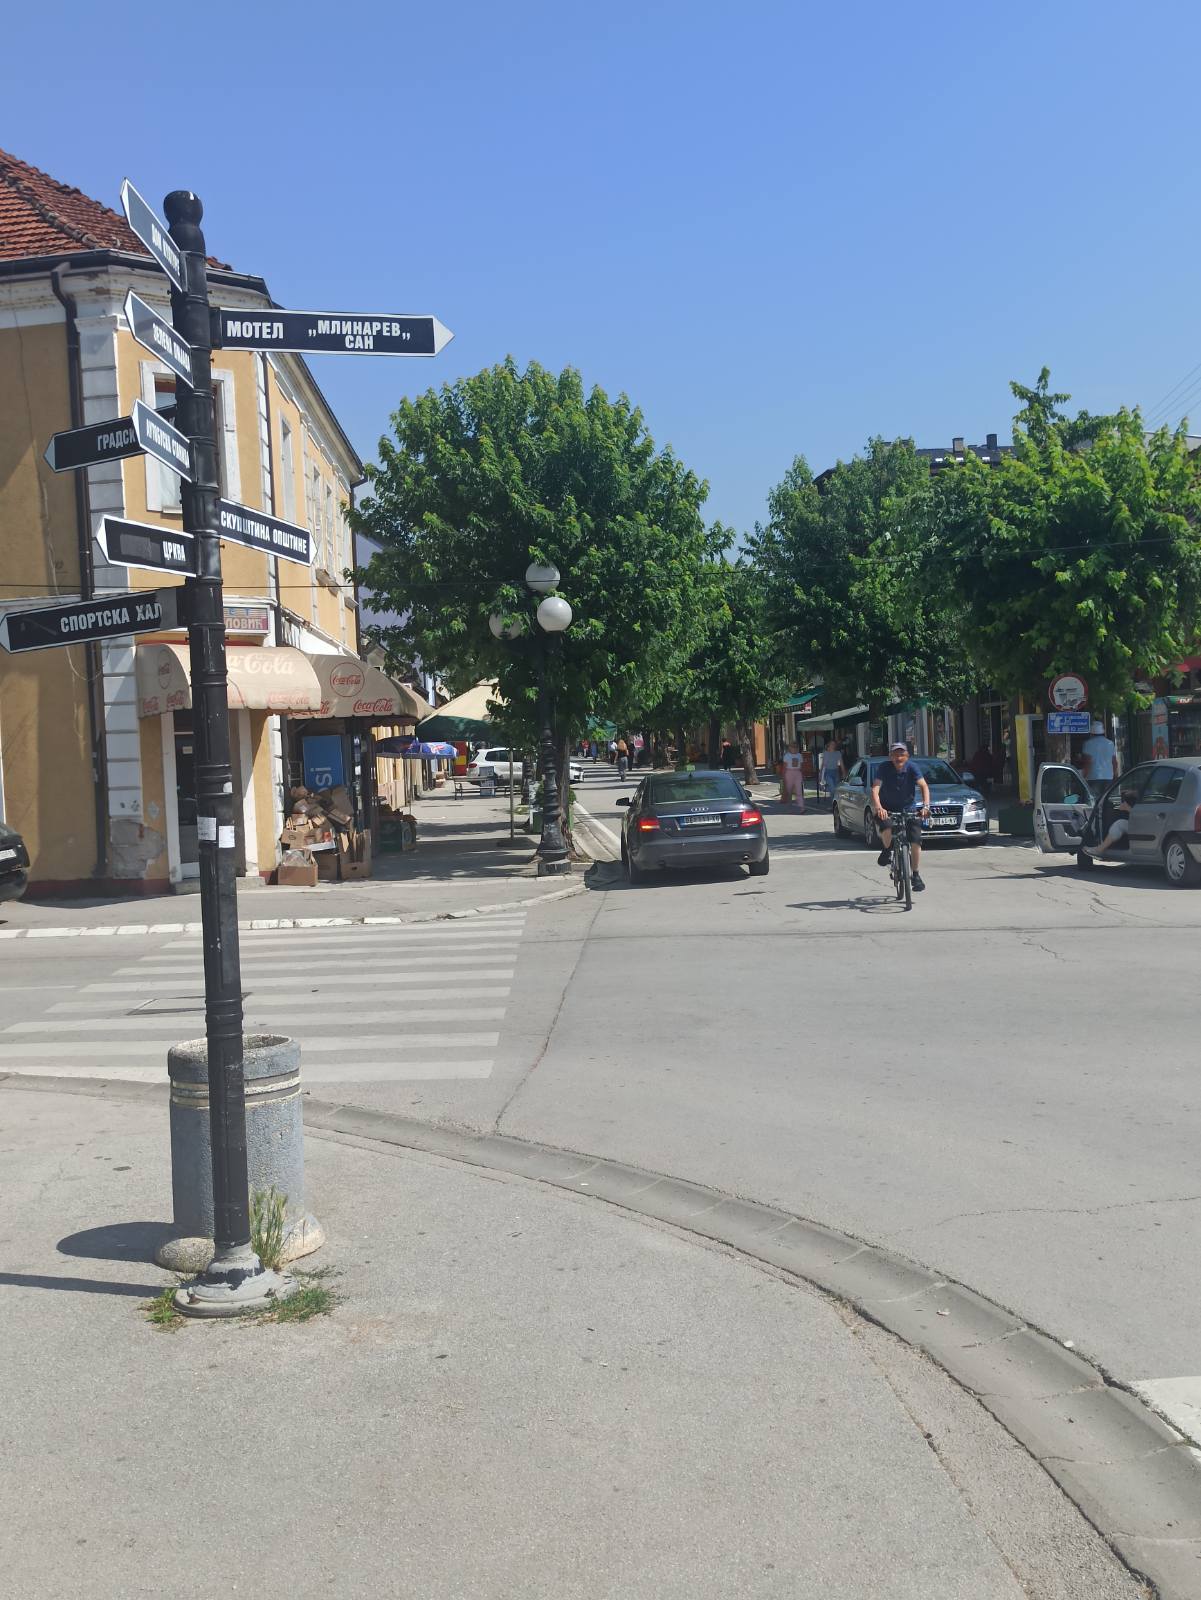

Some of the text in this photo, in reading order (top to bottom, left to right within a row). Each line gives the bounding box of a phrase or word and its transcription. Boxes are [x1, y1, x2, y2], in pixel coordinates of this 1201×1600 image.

[227, 320, 284, 339] МОТЕЛ
[345, 336, 374, 350] САН
[97, 428, 137, 451] ГРАДСК
[220, 510, 308, 555] СКУПШТИНА ОПШТИНЕ
[162, 540, 187, 562] ЦРКВА
[60, 602, 163, 634] СПОРТСКА ХАЛ
